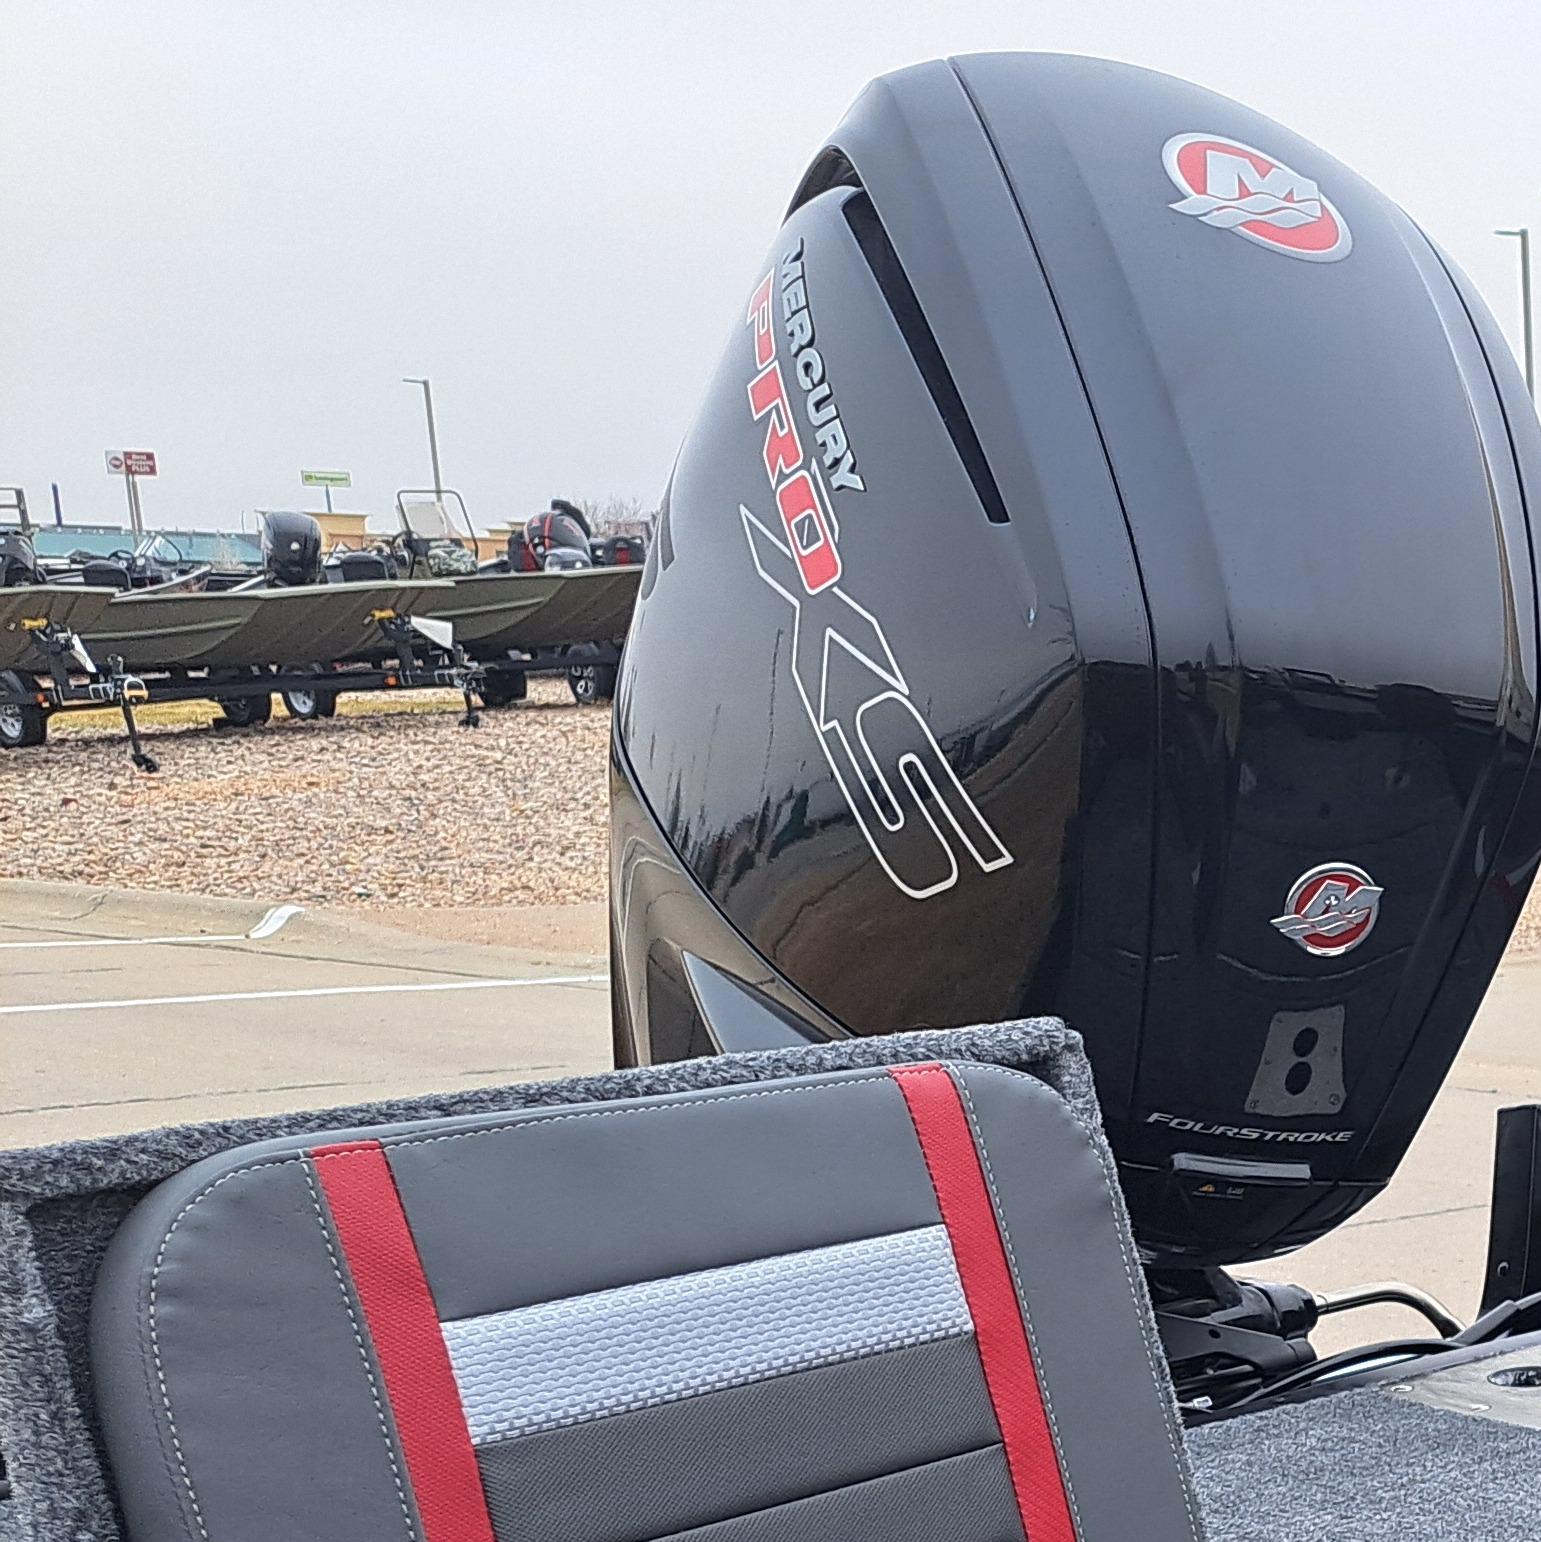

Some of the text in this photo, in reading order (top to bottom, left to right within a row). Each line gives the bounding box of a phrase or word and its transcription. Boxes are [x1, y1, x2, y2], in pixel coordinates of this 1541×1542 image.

[739, 266, 1014, 899] PRO XS
[778, 238, 867, 493] MERCURY
